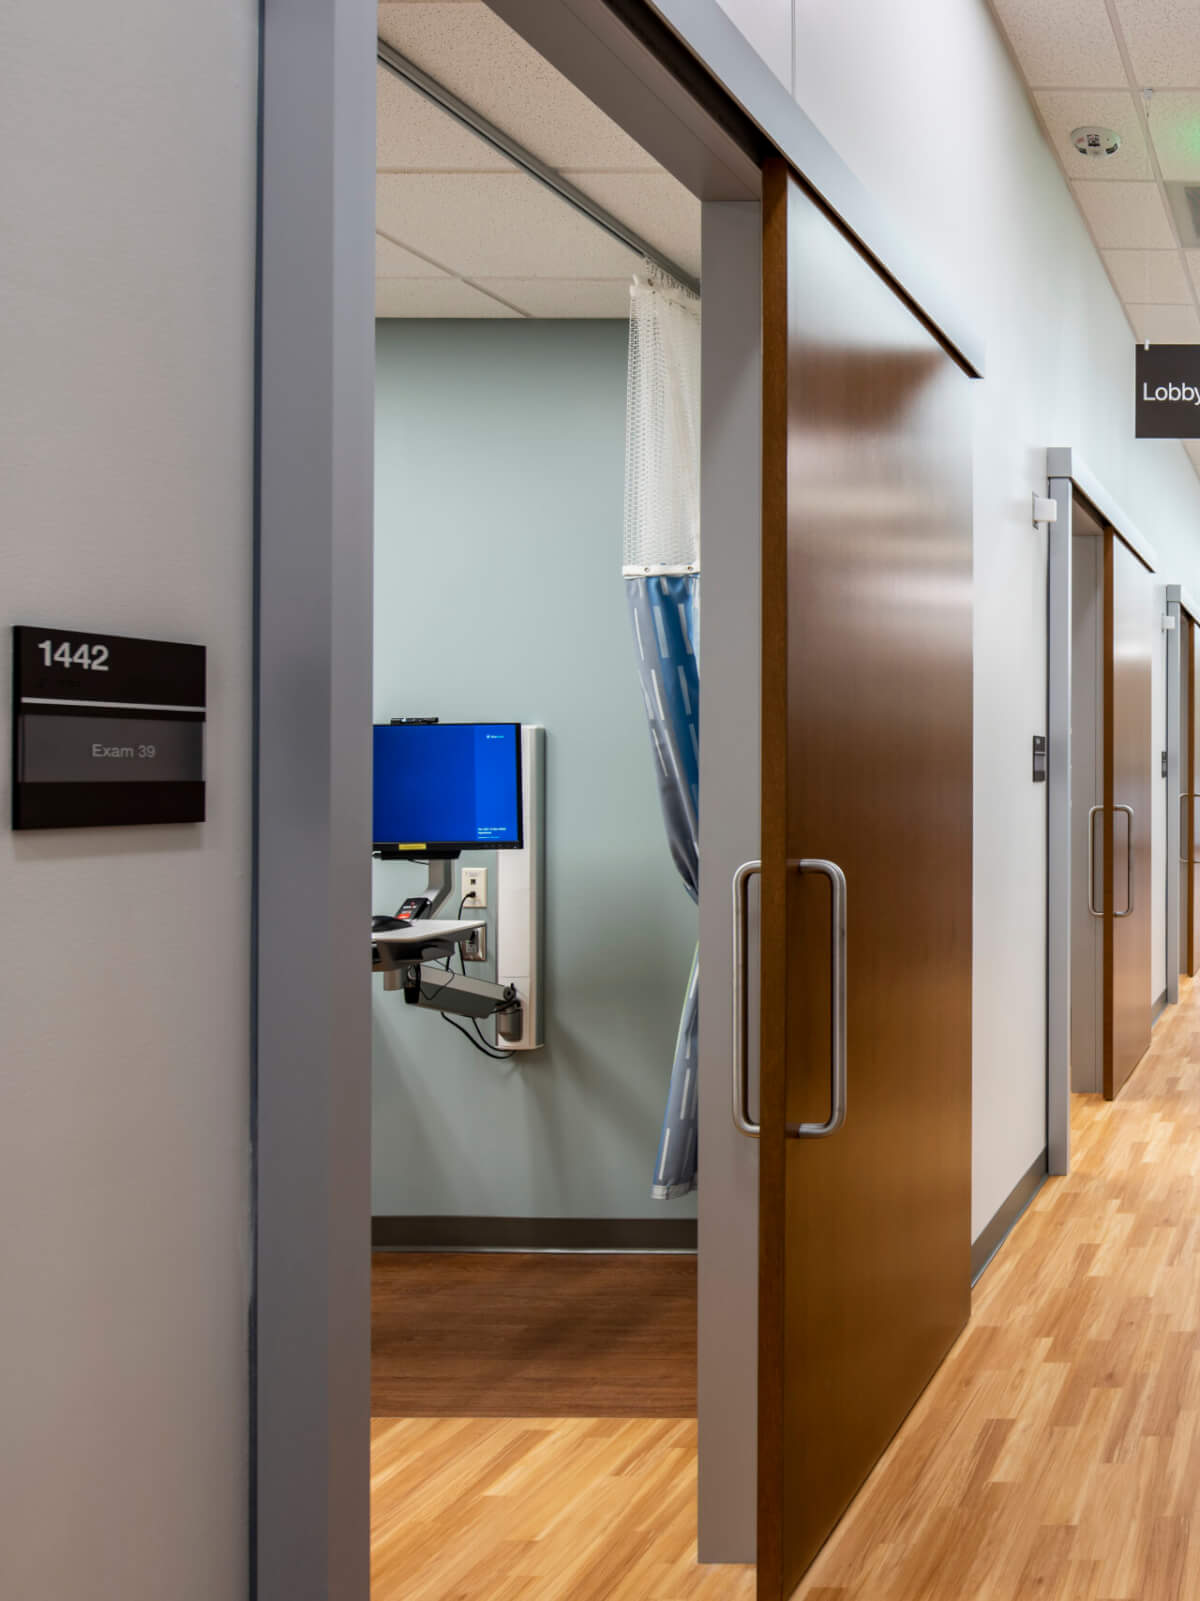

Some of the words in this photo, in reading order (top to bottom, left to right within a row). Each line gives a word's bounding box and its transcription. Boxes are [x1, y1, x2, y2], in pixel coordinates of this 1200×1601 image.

[38, 639, 109, 671] 1442
[91, 743, 134, 758] Exam
[138, 744, 156, 759] 39
